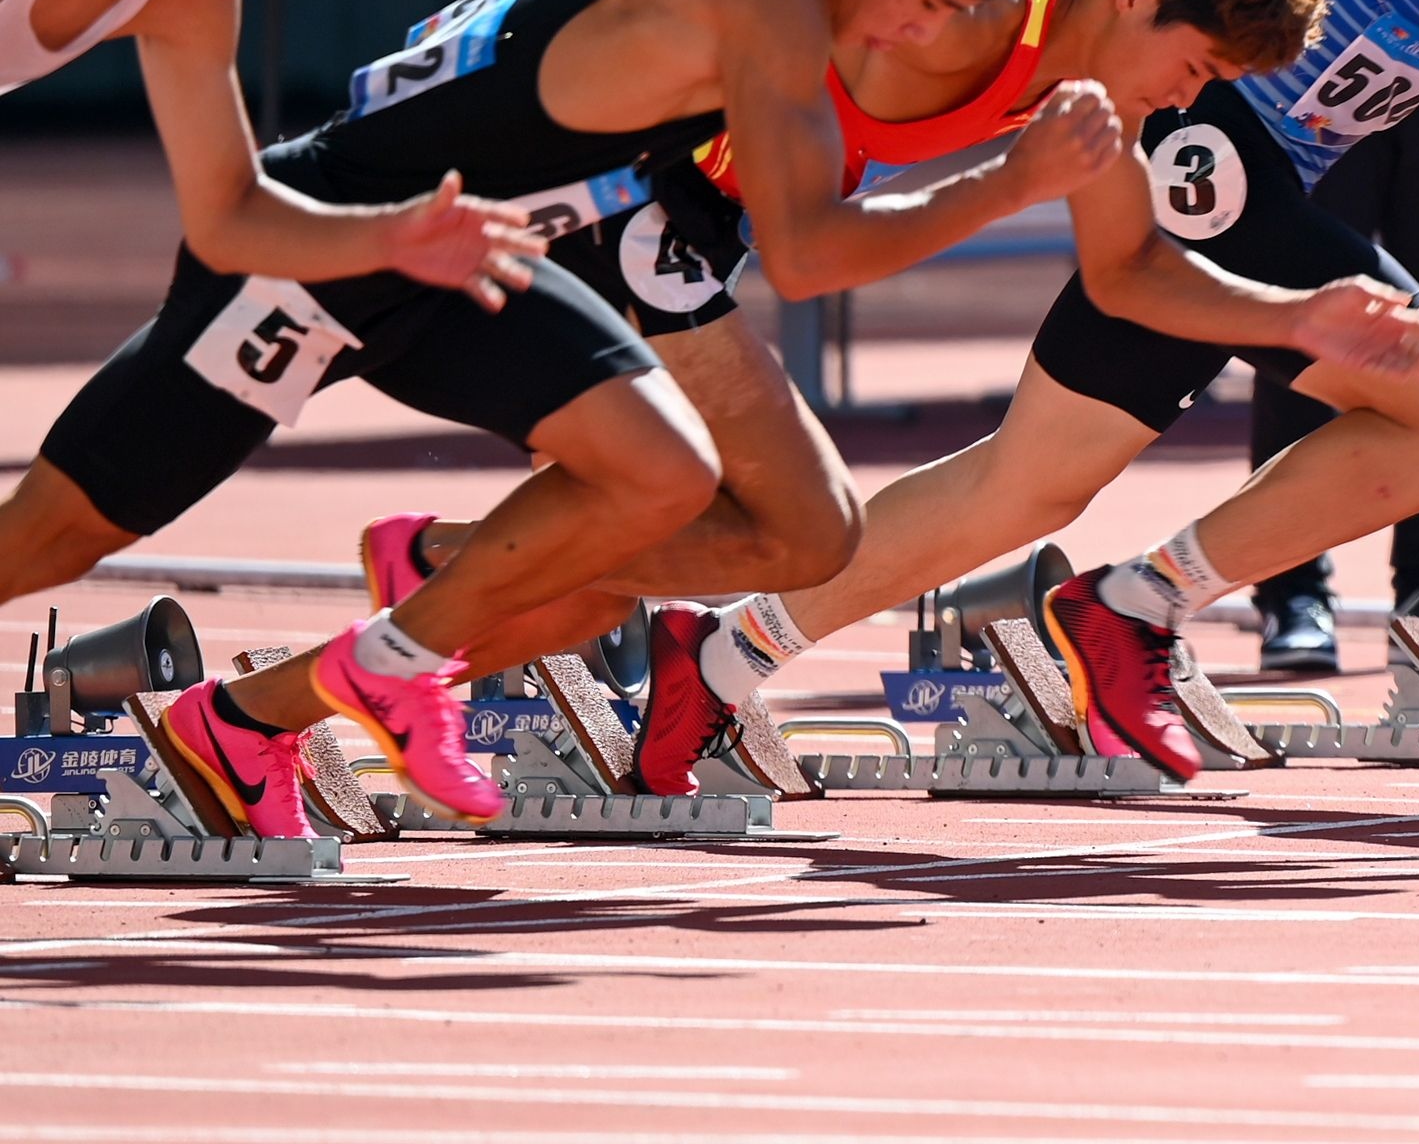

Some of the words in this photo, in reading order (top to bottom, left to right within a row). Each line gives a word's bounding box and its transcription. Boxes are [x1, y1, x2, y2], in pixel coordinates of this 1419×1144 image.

[1168, 144, 1217, 216] 3
[654, 220, 705, 284] 4
[236, 306, 310, 384] 5
[61, 748, 137, 768] 金陵体育
[61, 768, 97, 777] JINLING
